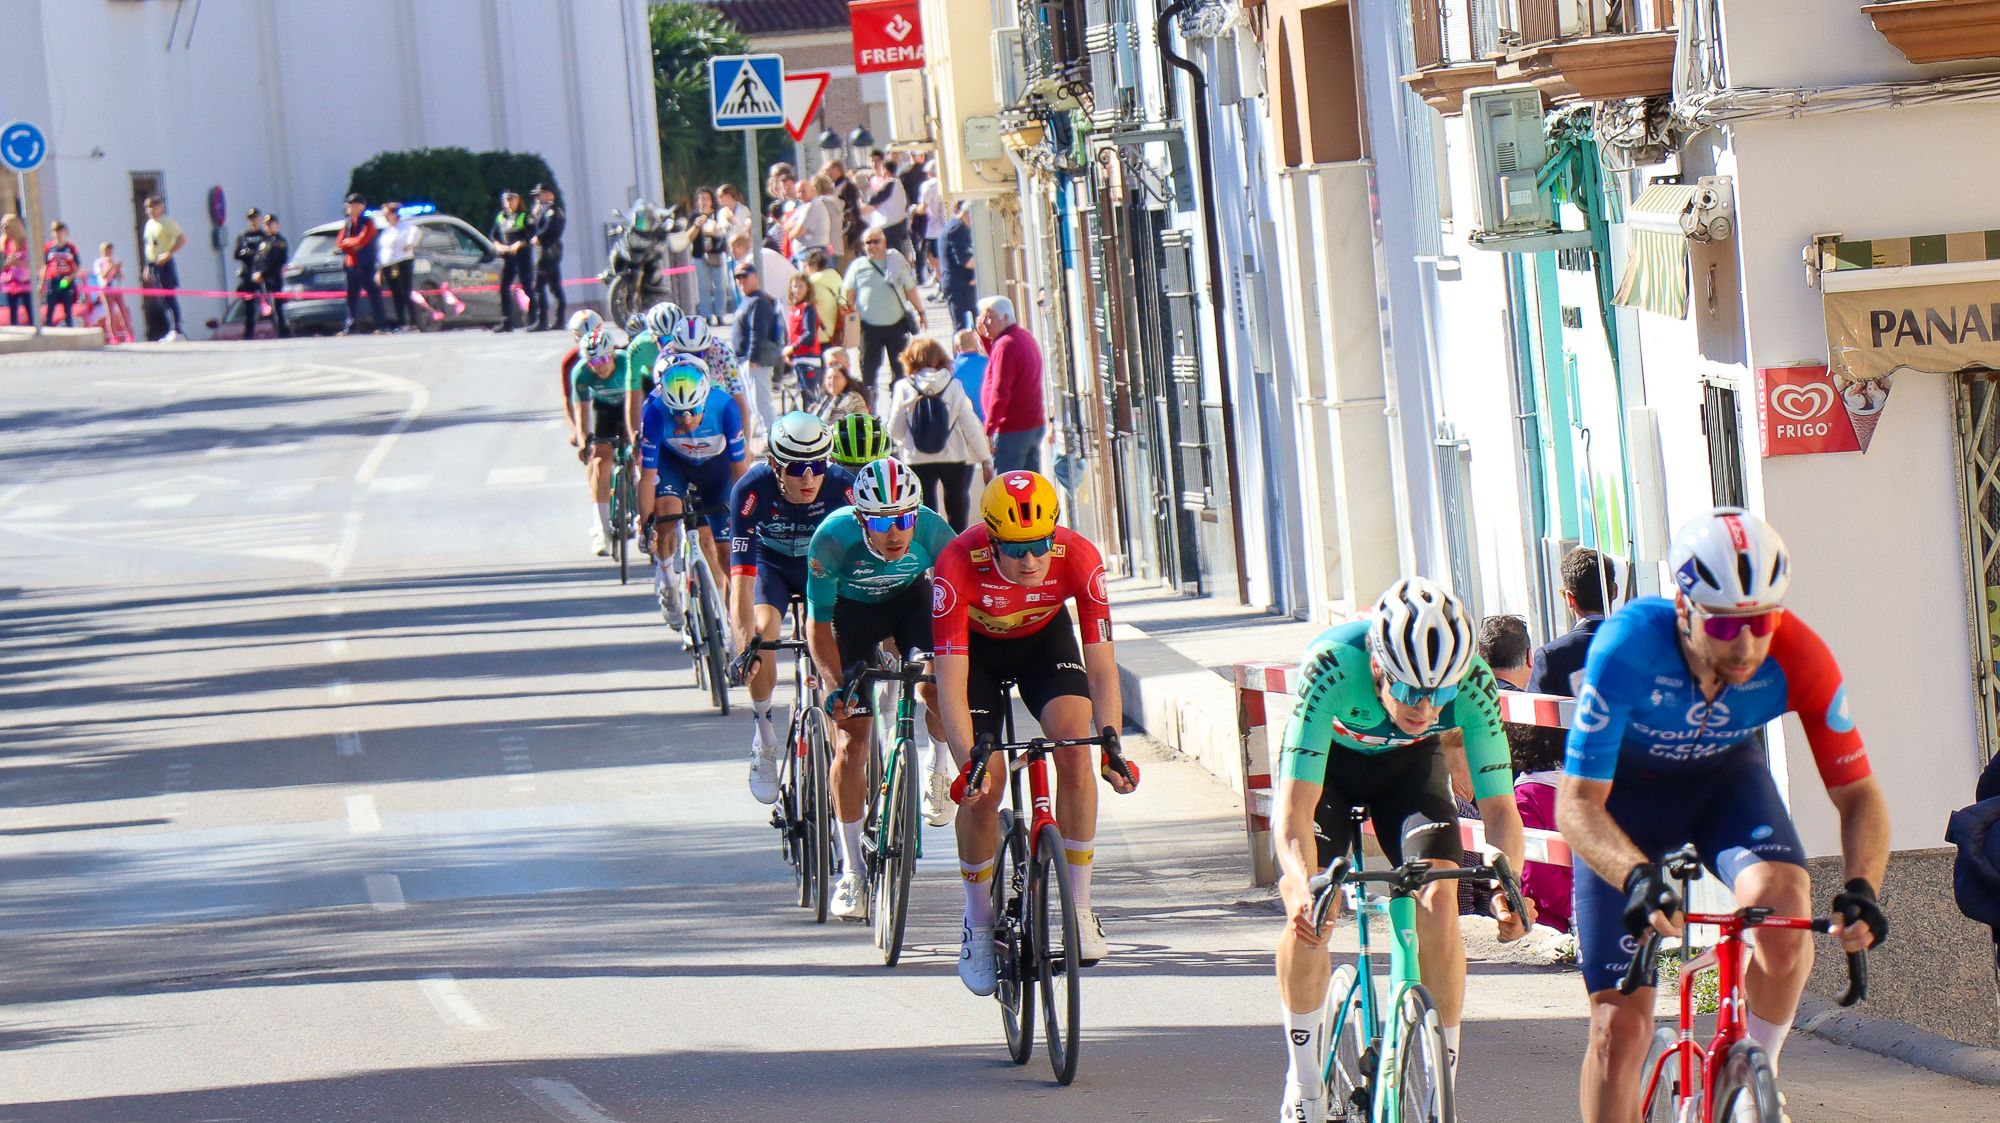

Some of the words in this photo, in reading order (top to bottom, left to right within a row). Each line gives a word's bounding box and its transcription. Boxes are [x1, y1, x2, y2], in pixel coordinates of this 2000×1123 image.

[1777, 422, 1828, 439] FRIGO
[981, 583, 1012, 591] RIDLEY
[1303, 671, 1346, 723] PHARMA
[1459, 683, 1499, 737] PHARMA
